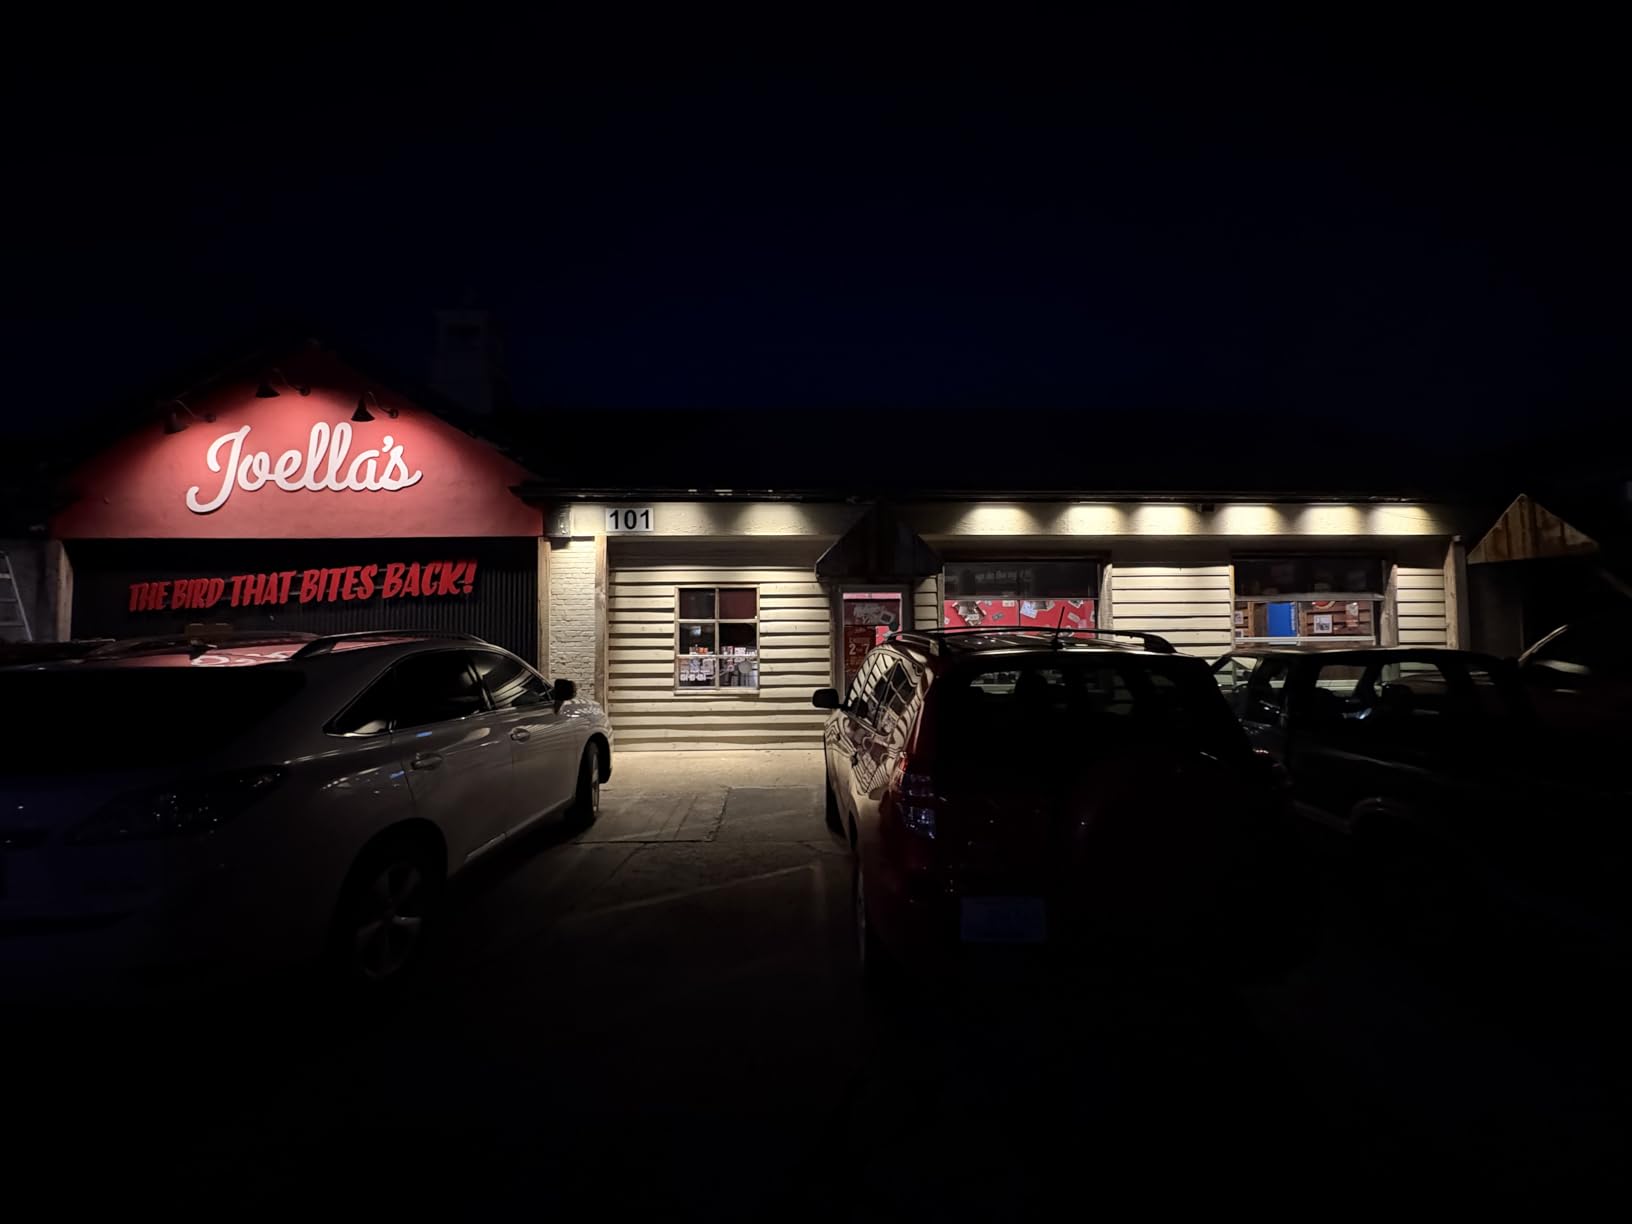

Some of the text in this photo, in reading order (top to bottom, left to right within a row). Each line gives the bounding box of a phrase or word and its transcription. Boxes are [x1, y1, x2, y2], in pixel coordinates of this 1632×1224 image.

[186, 421, 423, 514] Joella's
[609, 509, 650, 530] 101
[129, 559, 478, 612] THE BIRD THAT BITES BACK!
